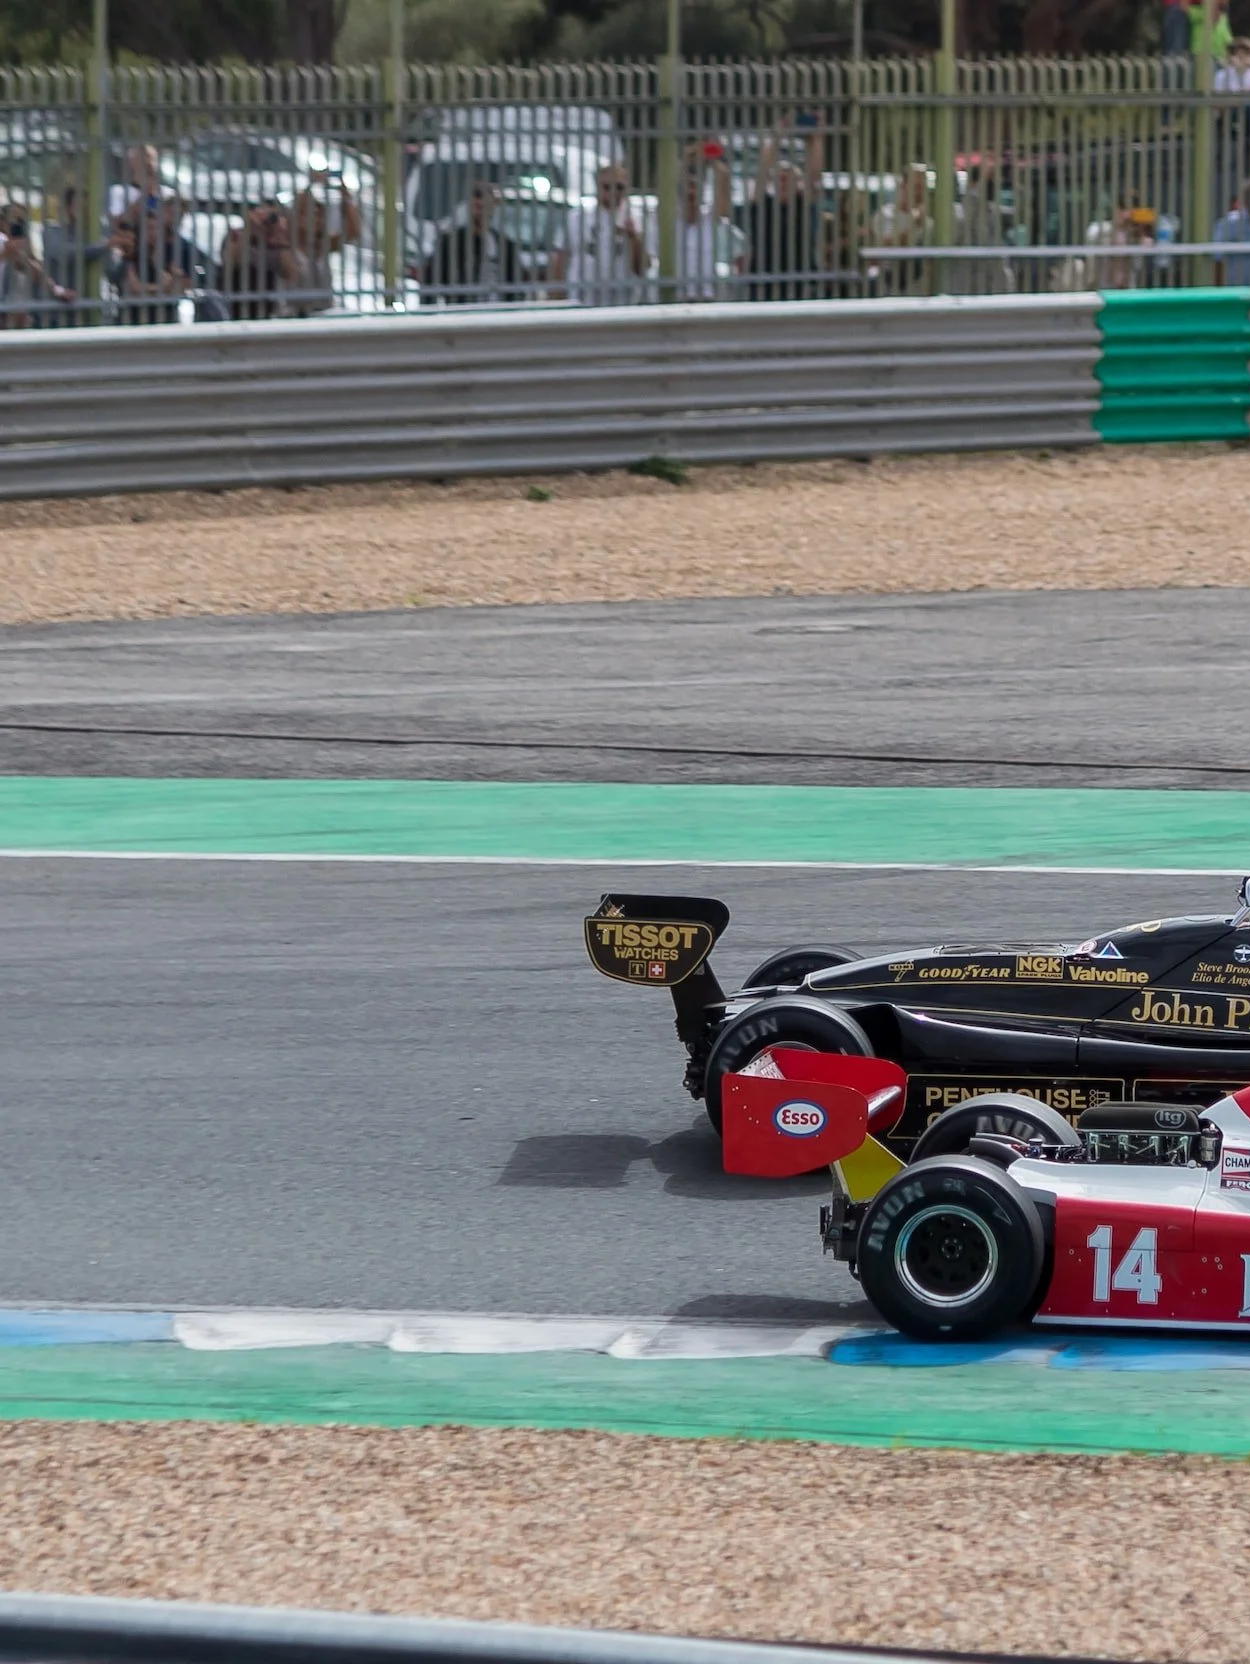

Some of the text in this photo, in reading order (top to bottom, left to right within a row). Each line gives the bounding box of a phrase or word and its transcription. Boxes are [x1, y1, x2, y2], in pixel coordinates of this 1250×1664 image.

[596, 923, 698, 949] TISSOT
[614, 947, 679, 961] WATCHES
[918, 963, 1010, 980] GOODYEAR
[1018, 956, 1061, 973] NGK
[1196, 961, 1223, 973] Steve
[1068, 965, 1149, 984] Valvoline
[1191, 972, 1213, 984] Elio
[1213, 973, 1227, 984] de
[1131, 990, 1215, 1027] John
[781, 1109, 820, 1126] Esso
[1086, 1224, 1163, 1305] 14
